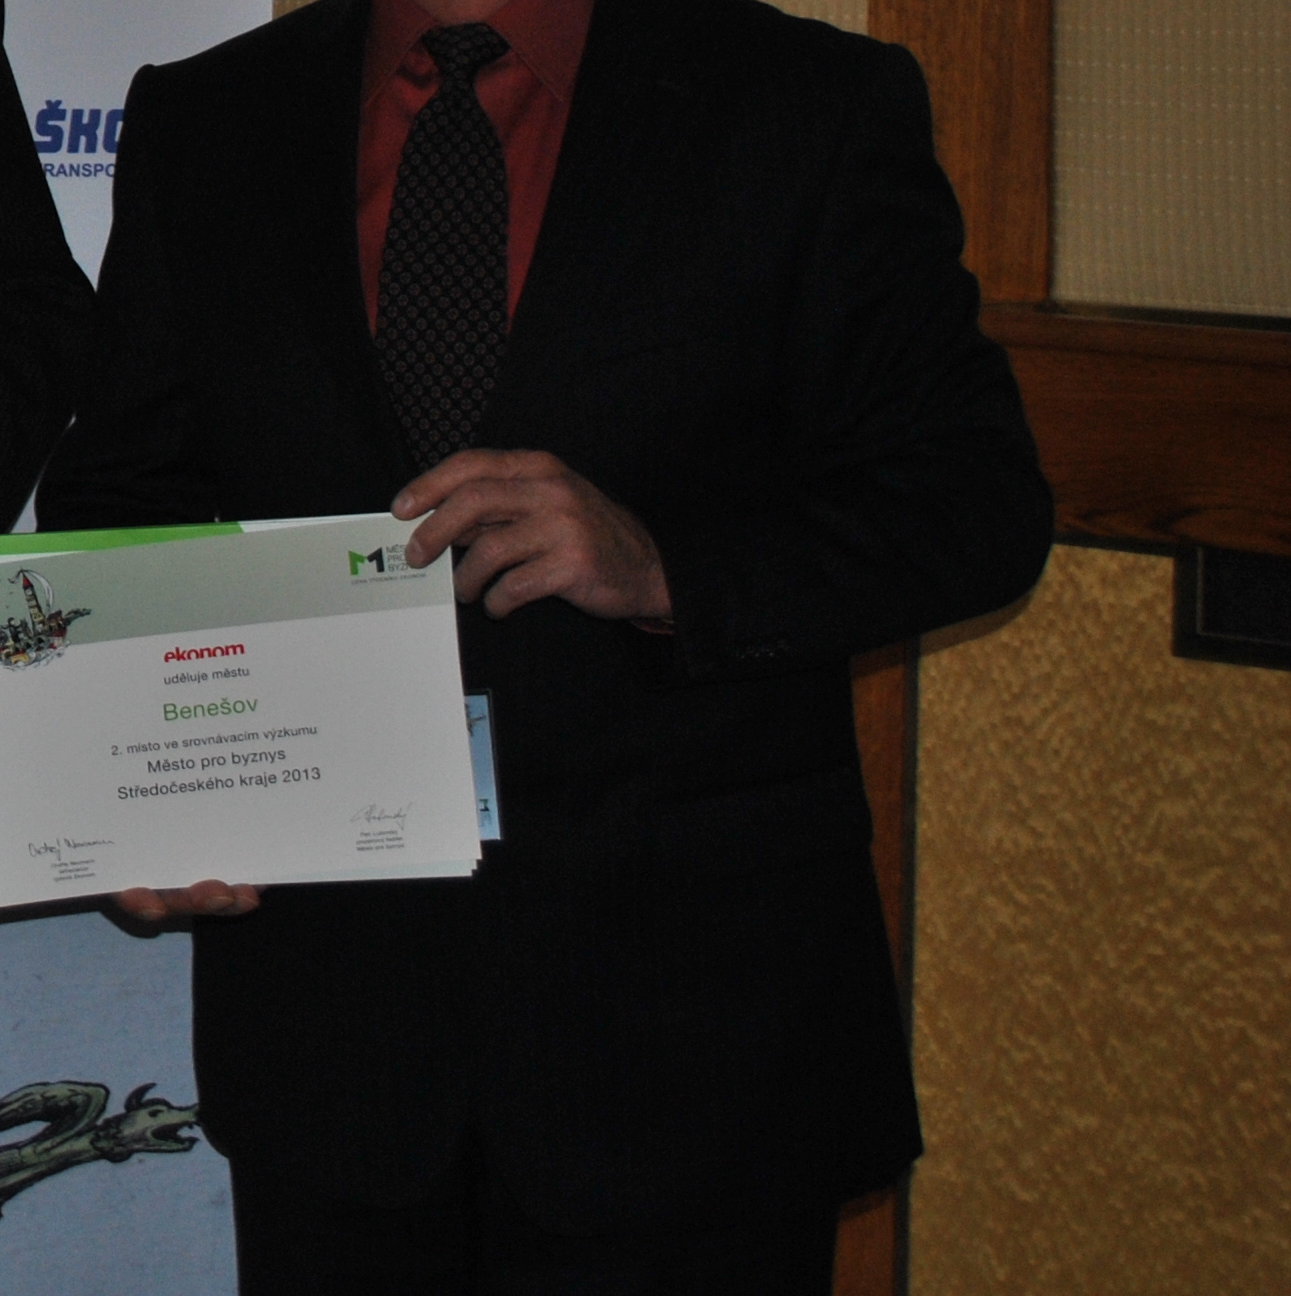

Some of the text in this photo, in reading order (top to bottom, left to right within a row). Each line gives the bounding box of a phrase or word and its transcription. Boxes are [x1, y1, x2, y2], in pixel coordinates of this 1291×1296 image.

[164, 643, 245, 663] ekonom
[163, 667, 250, 685] uděluje městu
[163, 697, 259, 722] Benešov
[111, 745, 123, 756] 2.
[164, 740, 179, 750] ve
[182, 730, 260, 748] srovnávacím
[263, 725, 318, 741] výzkumu
[147, 749, 287, 774] Město pro byznys
[117, 766, 321, 800] Středočeského kraje 2013
